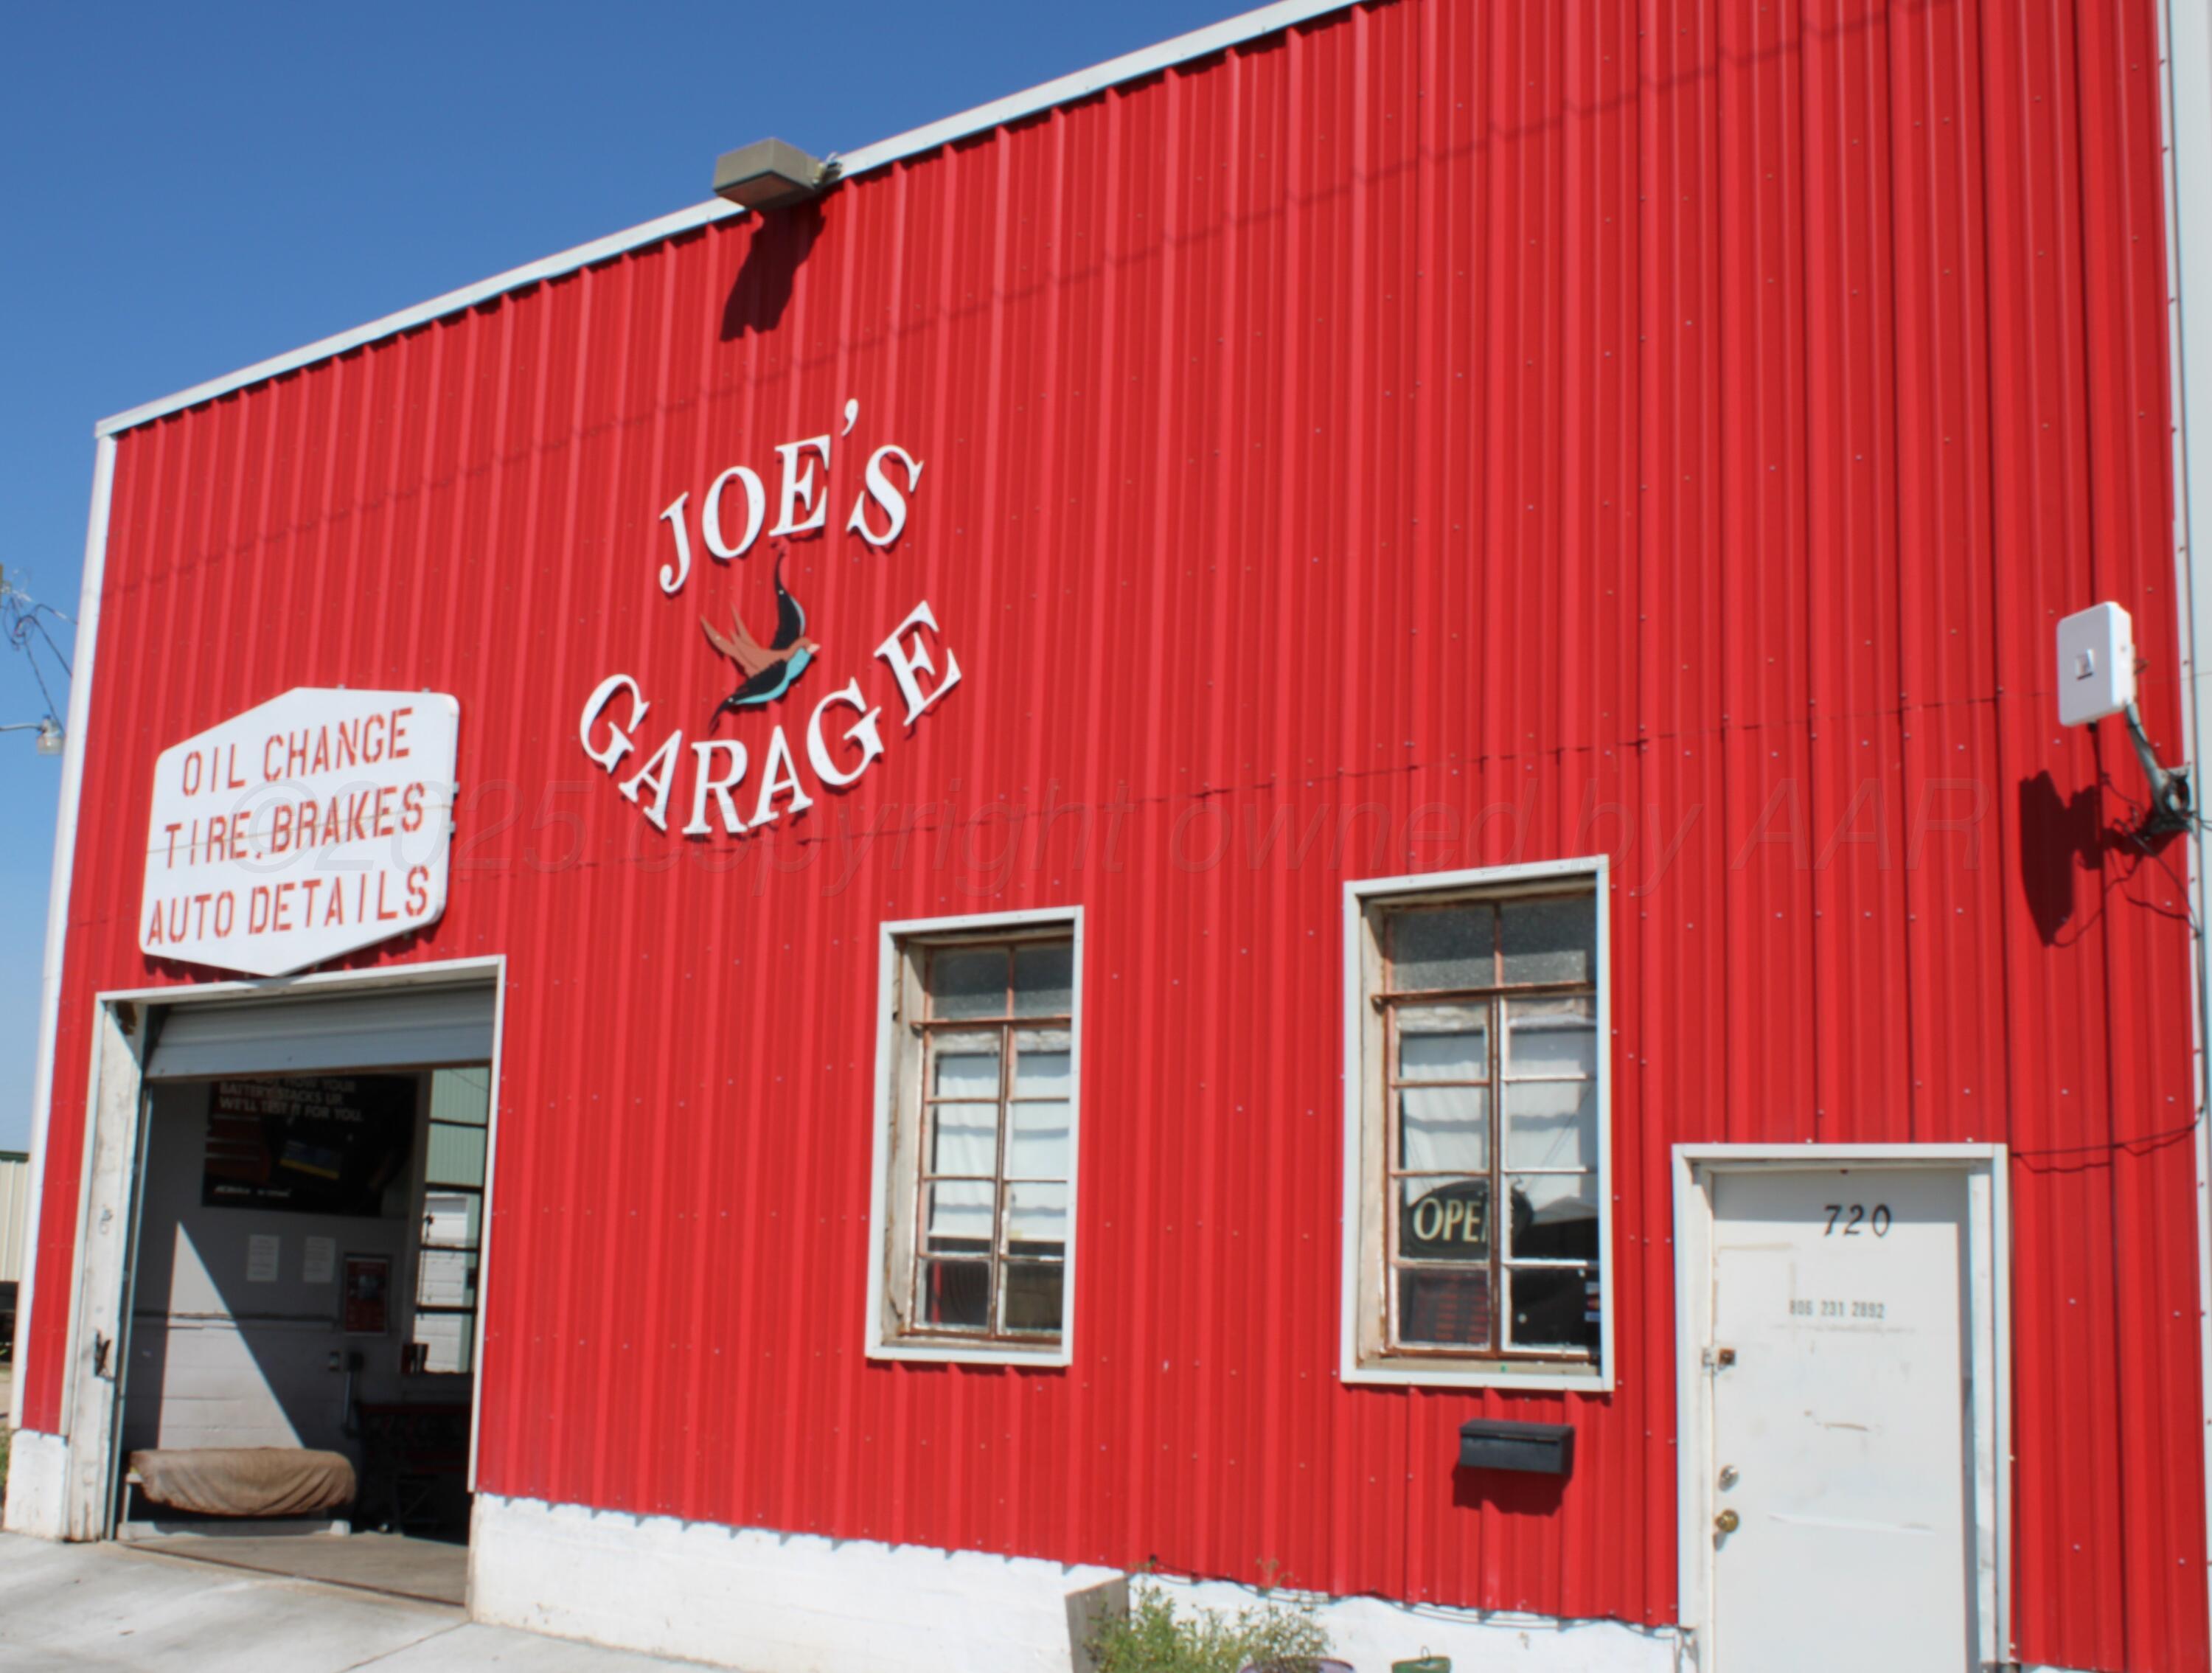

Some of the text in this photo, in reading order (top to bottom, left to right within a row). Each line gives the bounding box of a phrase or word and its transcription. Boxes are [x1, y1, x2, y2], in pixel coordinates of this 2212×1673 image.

[659, 398, 924, 593] JOE'S
[182, 706, 413, 796] OIL CHANGE
[580, 600, 961, 835] GARAGE
[146, 866, 429, 946] AUTO DETAILS
[1413, 1197, 1489, 1242] OPE
[1823, 1203, 1892, 1238] 720
